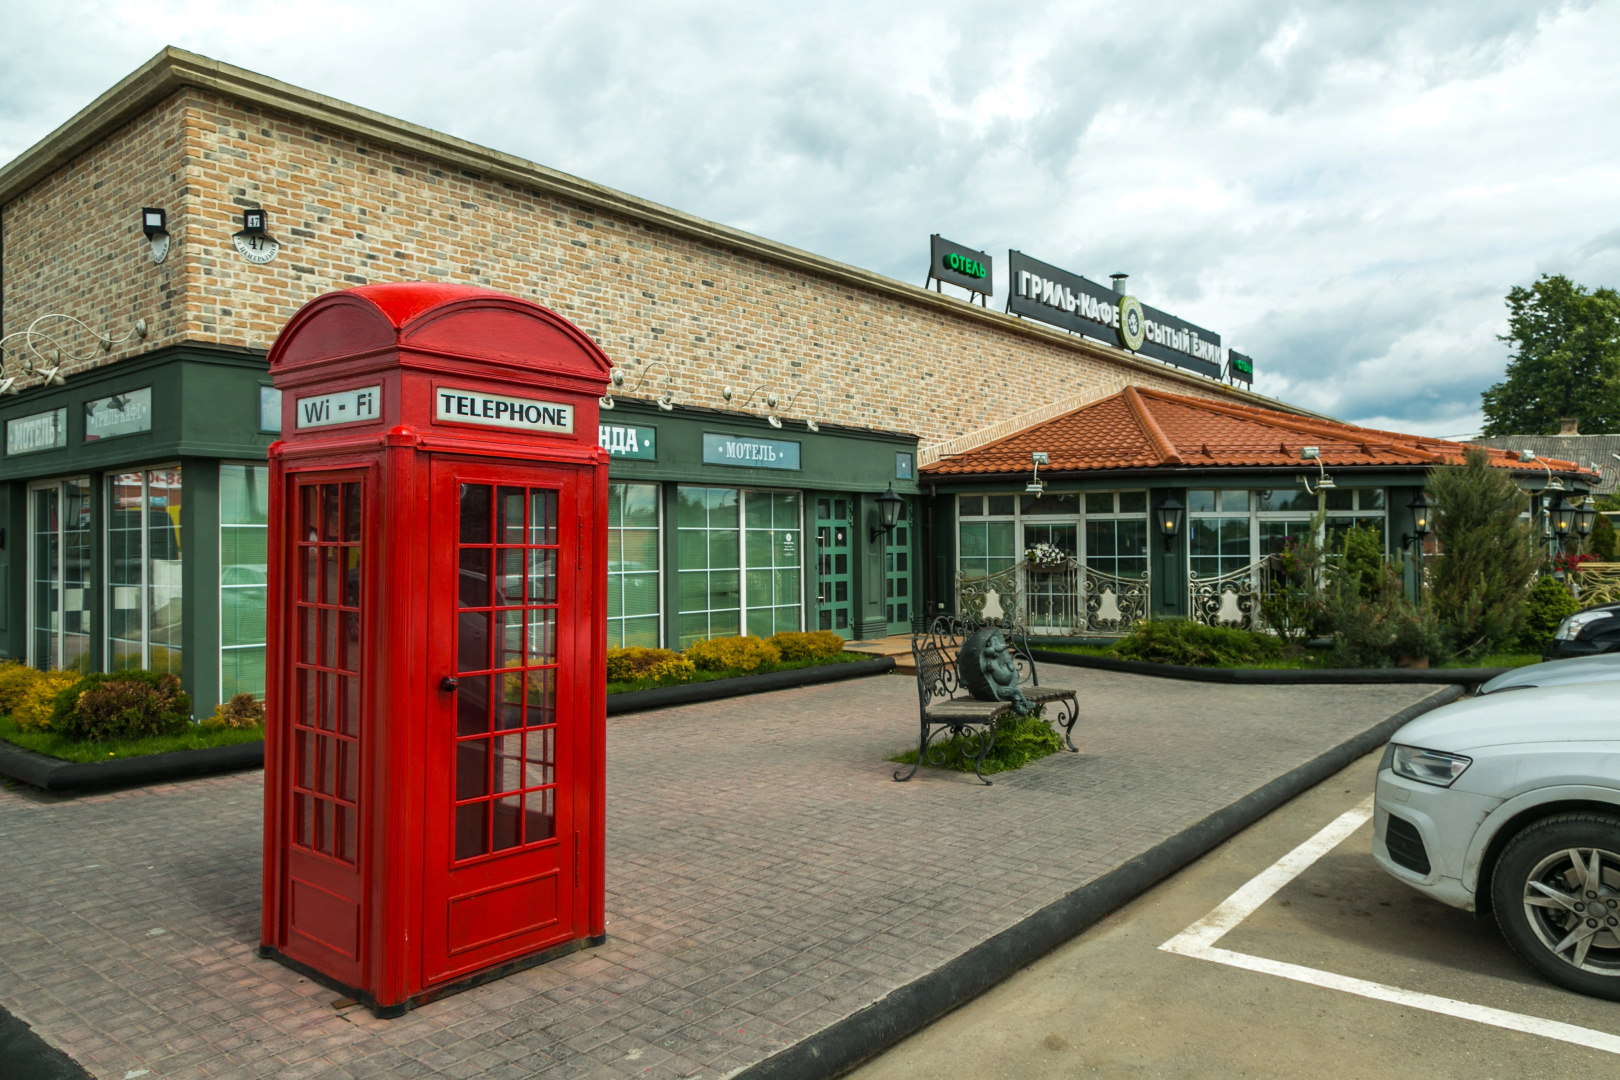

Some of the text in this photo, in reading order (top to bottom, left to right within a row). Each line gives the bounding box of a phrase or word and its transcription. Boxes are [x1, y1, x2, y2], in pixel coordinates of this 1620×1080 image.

[250, 217, 259, 227] 47
[248, 235, 265, 250] 47
[948, 252, 987, 279] ОТЕЛЬ
[1144, 319, 1190, 354] СЫТЫЙ
[1190, 331, 1221, 365] ЁЖИК
[440, 393, 567, 427] TELEPHONE
[14, 415, 56, 451] МОТЕЛЬ
[598, 425, 639, 455] НДА
[725, 441, 777, 462] МОТЕЛЬ
